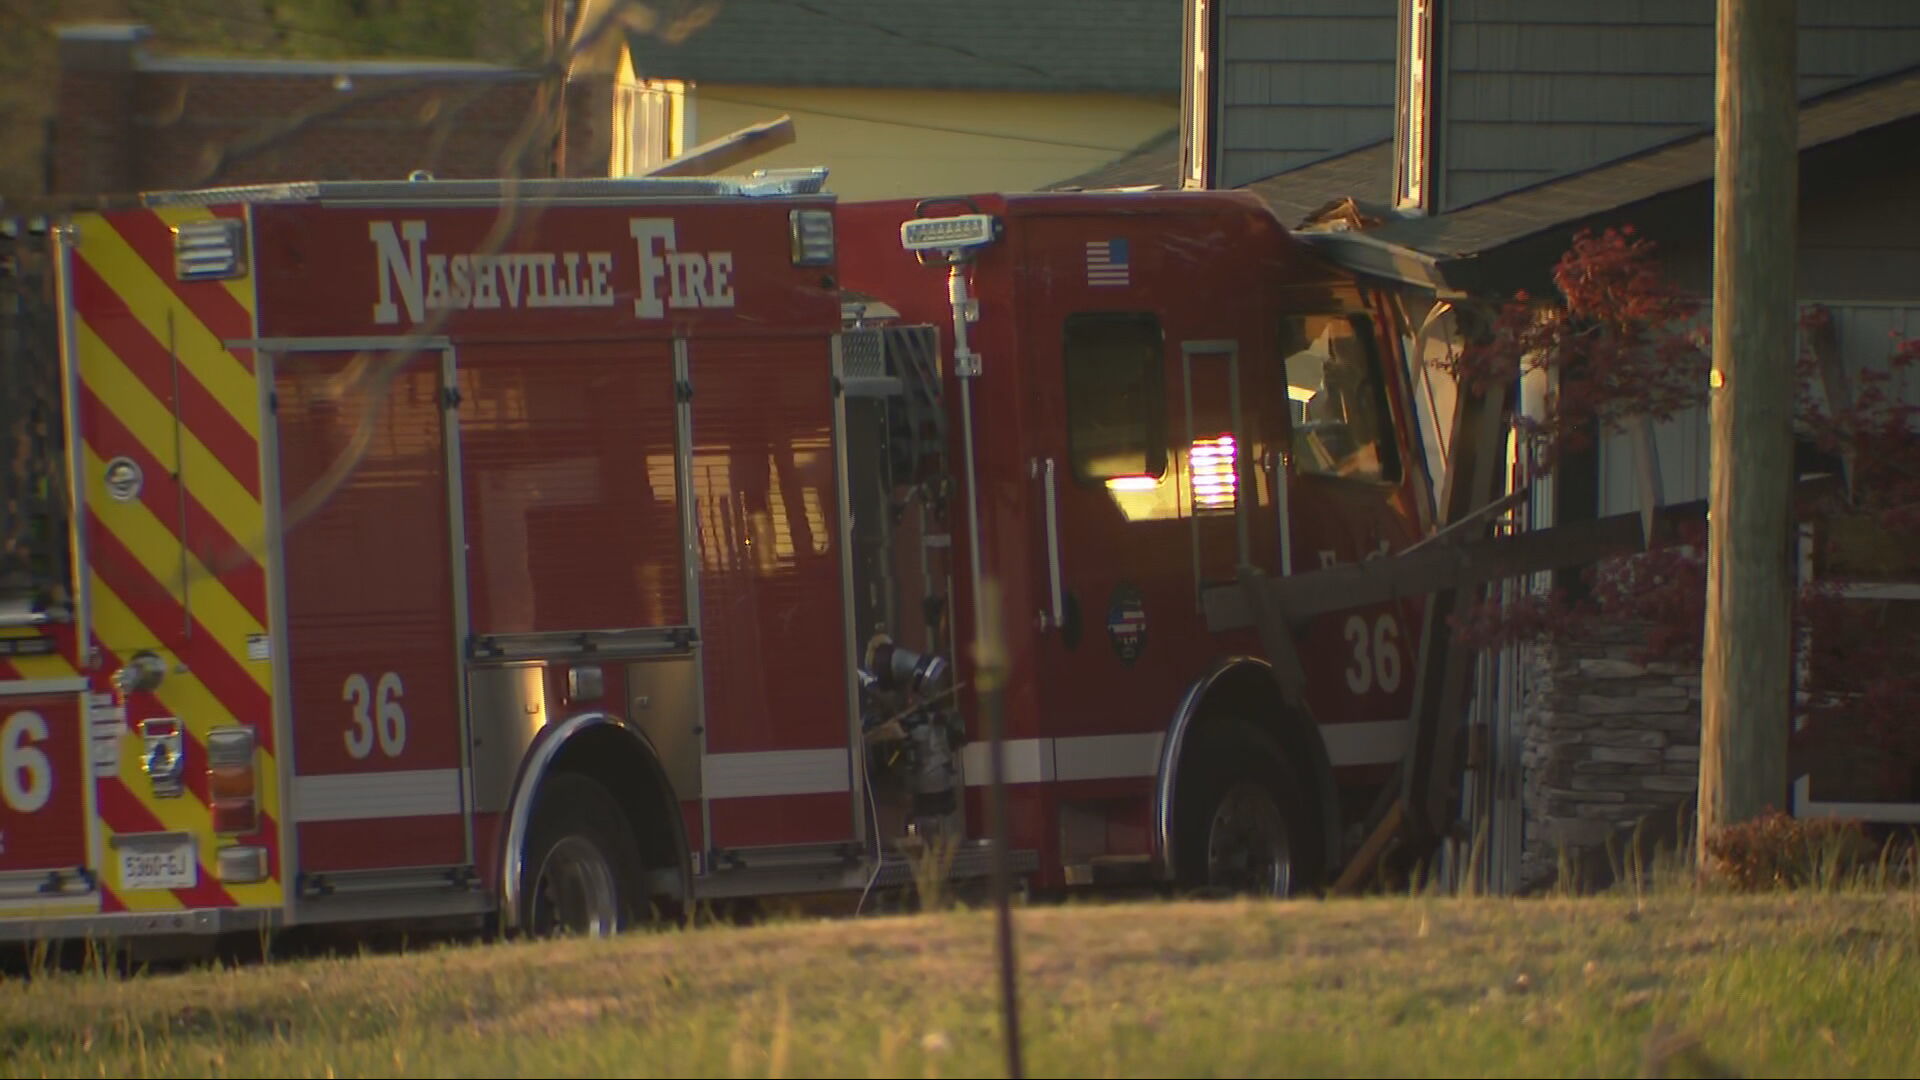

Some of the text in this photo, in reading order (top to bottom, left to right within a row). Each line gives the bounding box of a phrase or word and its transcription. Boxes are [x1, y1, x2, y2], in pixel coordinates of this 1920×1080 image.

[369, 218, 735, 324] NASHVILLE FIRE
[1344, 614, 1401, 694] 36
[343, 672, 406, 759] 36
